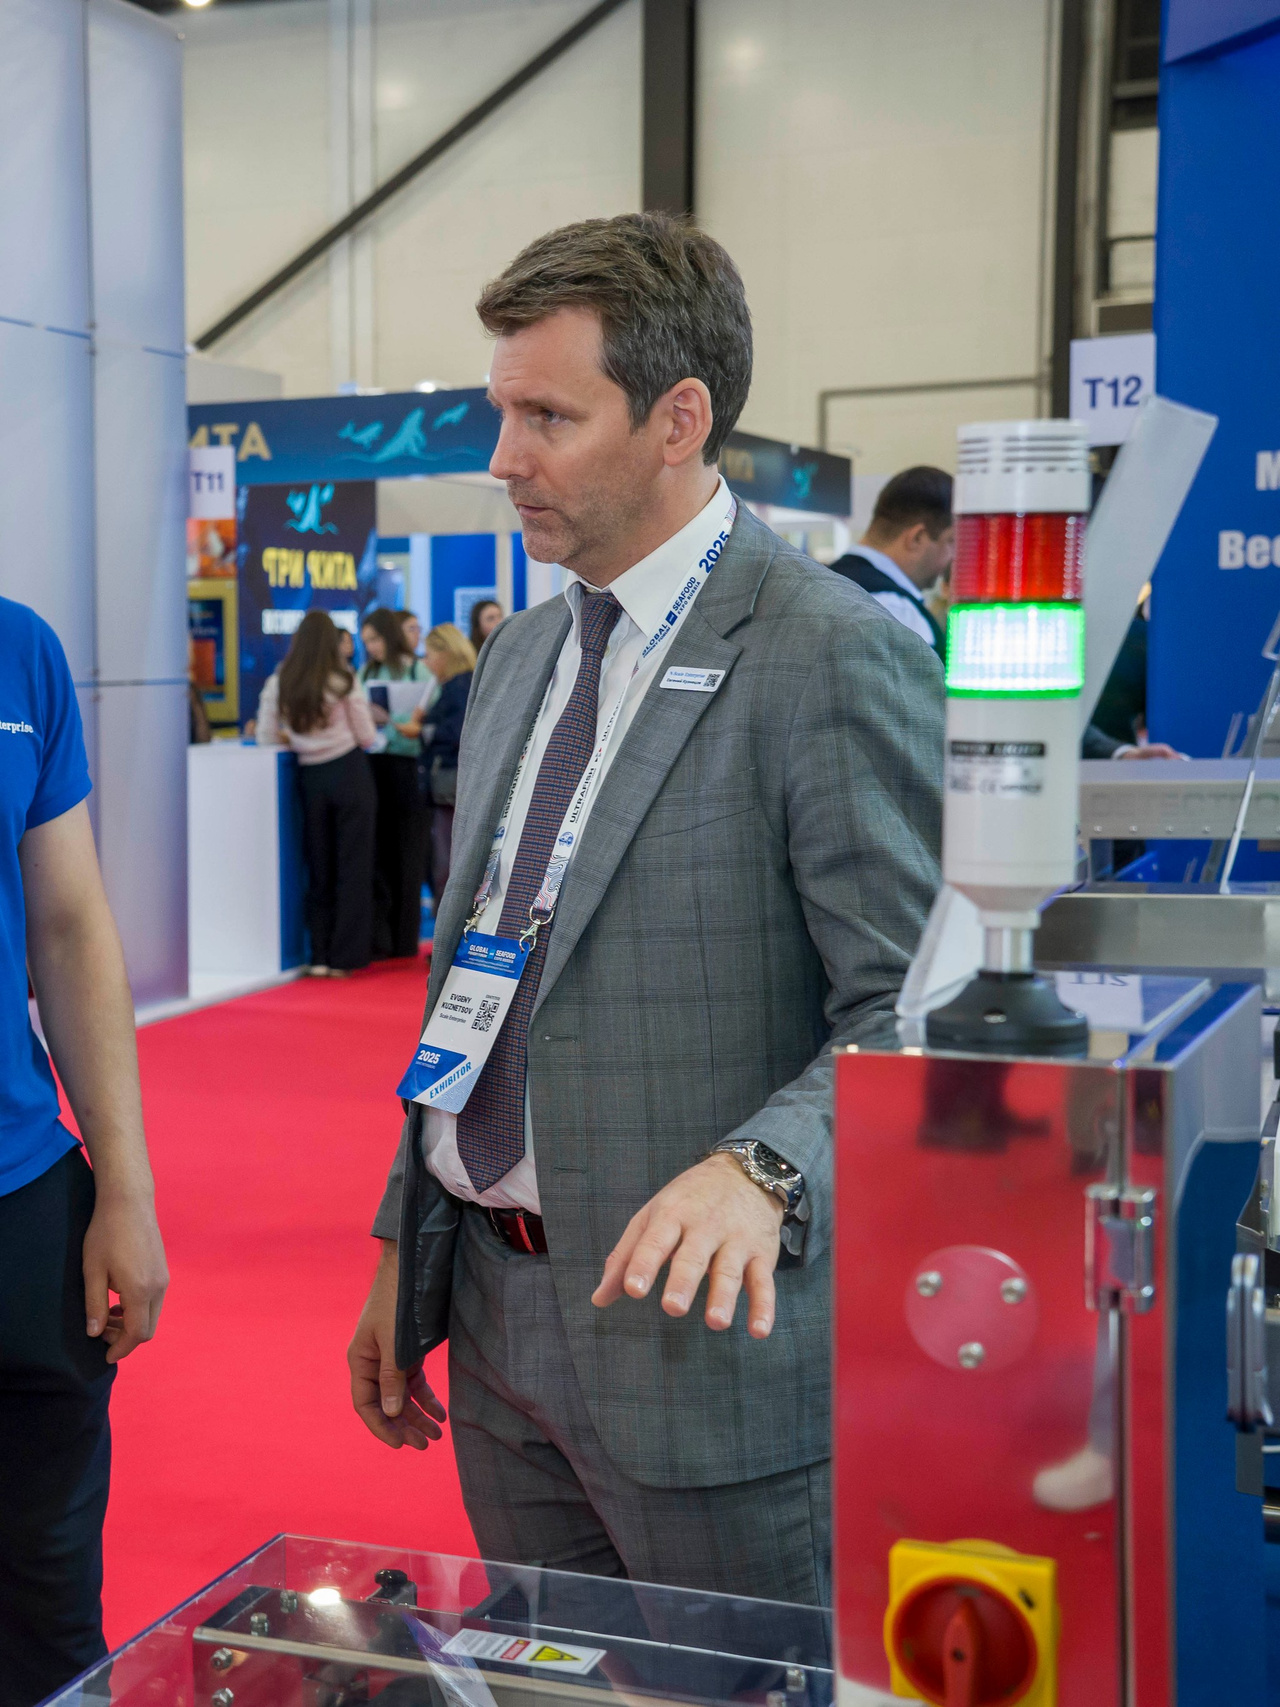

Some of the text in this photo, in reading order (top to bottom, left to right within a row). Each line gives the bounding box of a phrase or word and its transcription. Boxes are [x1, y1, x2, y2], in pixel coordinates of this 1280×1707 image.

[1083, 376, 1142, 409] T12
[192, 471, 224, 492] T11
[699, 530, 730, 573] 2025
[262, 547, 358, 590] ТРИ КИТА
[672, 576, 697, 612] SEAFOOD
[677, 581, 701, 615] EXPO RUSSIA
[642, 624, 668, 656] GLOBAL
[570, 767, 595, 823] ULTRAFISH
[469, 944, 489, 955] GLOBAL
[495, 950, 516, 960] SEAFOOD
[441, 1002, 473, 1015] KUZNETSOV
[450, 993, 472, 1004] EVGENY
[417, 1050, 441, 1065] 2025
[429, 1061, 472, 1099] EXHIBITOR
